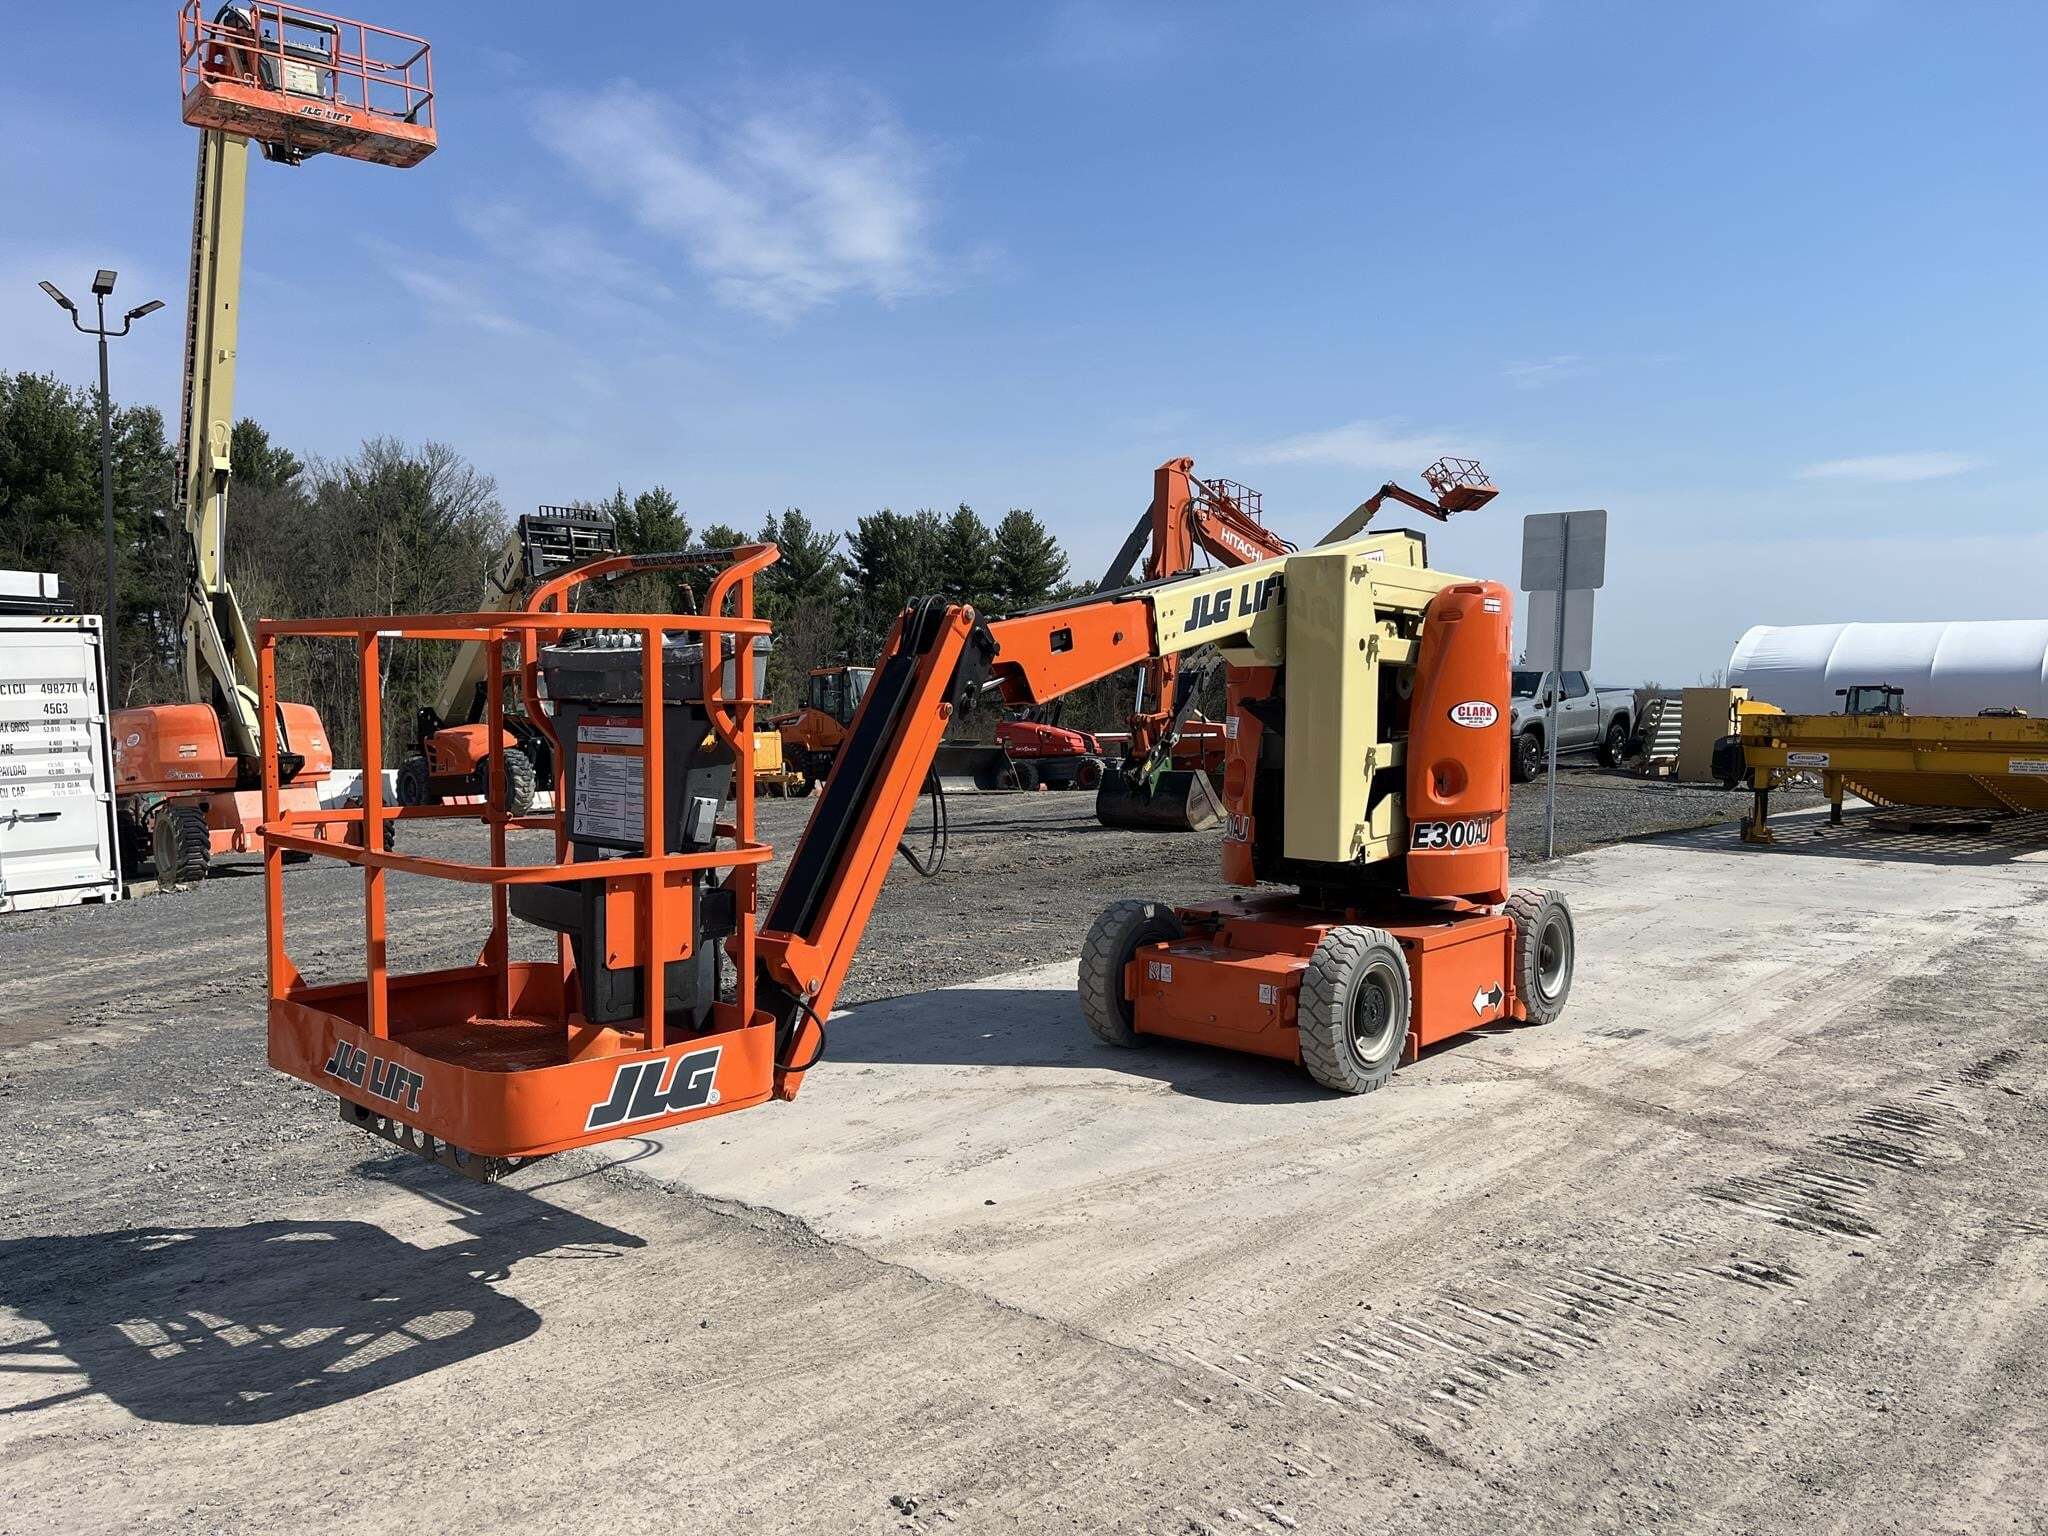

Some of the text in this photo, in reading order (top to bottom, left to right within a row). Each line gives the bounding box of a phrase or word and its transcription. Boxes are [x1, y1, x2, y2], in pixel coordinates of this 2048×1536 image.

[300, 105, 352, 123] JLG LIFT
[1221, 527, 1263, 562] HITACHI
[503, 551, 515, 584] JLG
[1183, 588, 1233, 633] JLG
[40, 682, 78, 694] 498270
[89, 682, 96, 693] 4
[43, 702, 69, 714] 45G3
[1458, 706, 1492, 716] CLARK
[11, 721, 30, 732] GROSS
[1, 743, 14, 755] ARE
[0, 765, 27, 777] PAYLOAD
[1411, 817, 1491, 849] E300AJ
[324, 1039, 424, 1112] JLG LIFT
[584, 1045, 724, 1132] JLG
